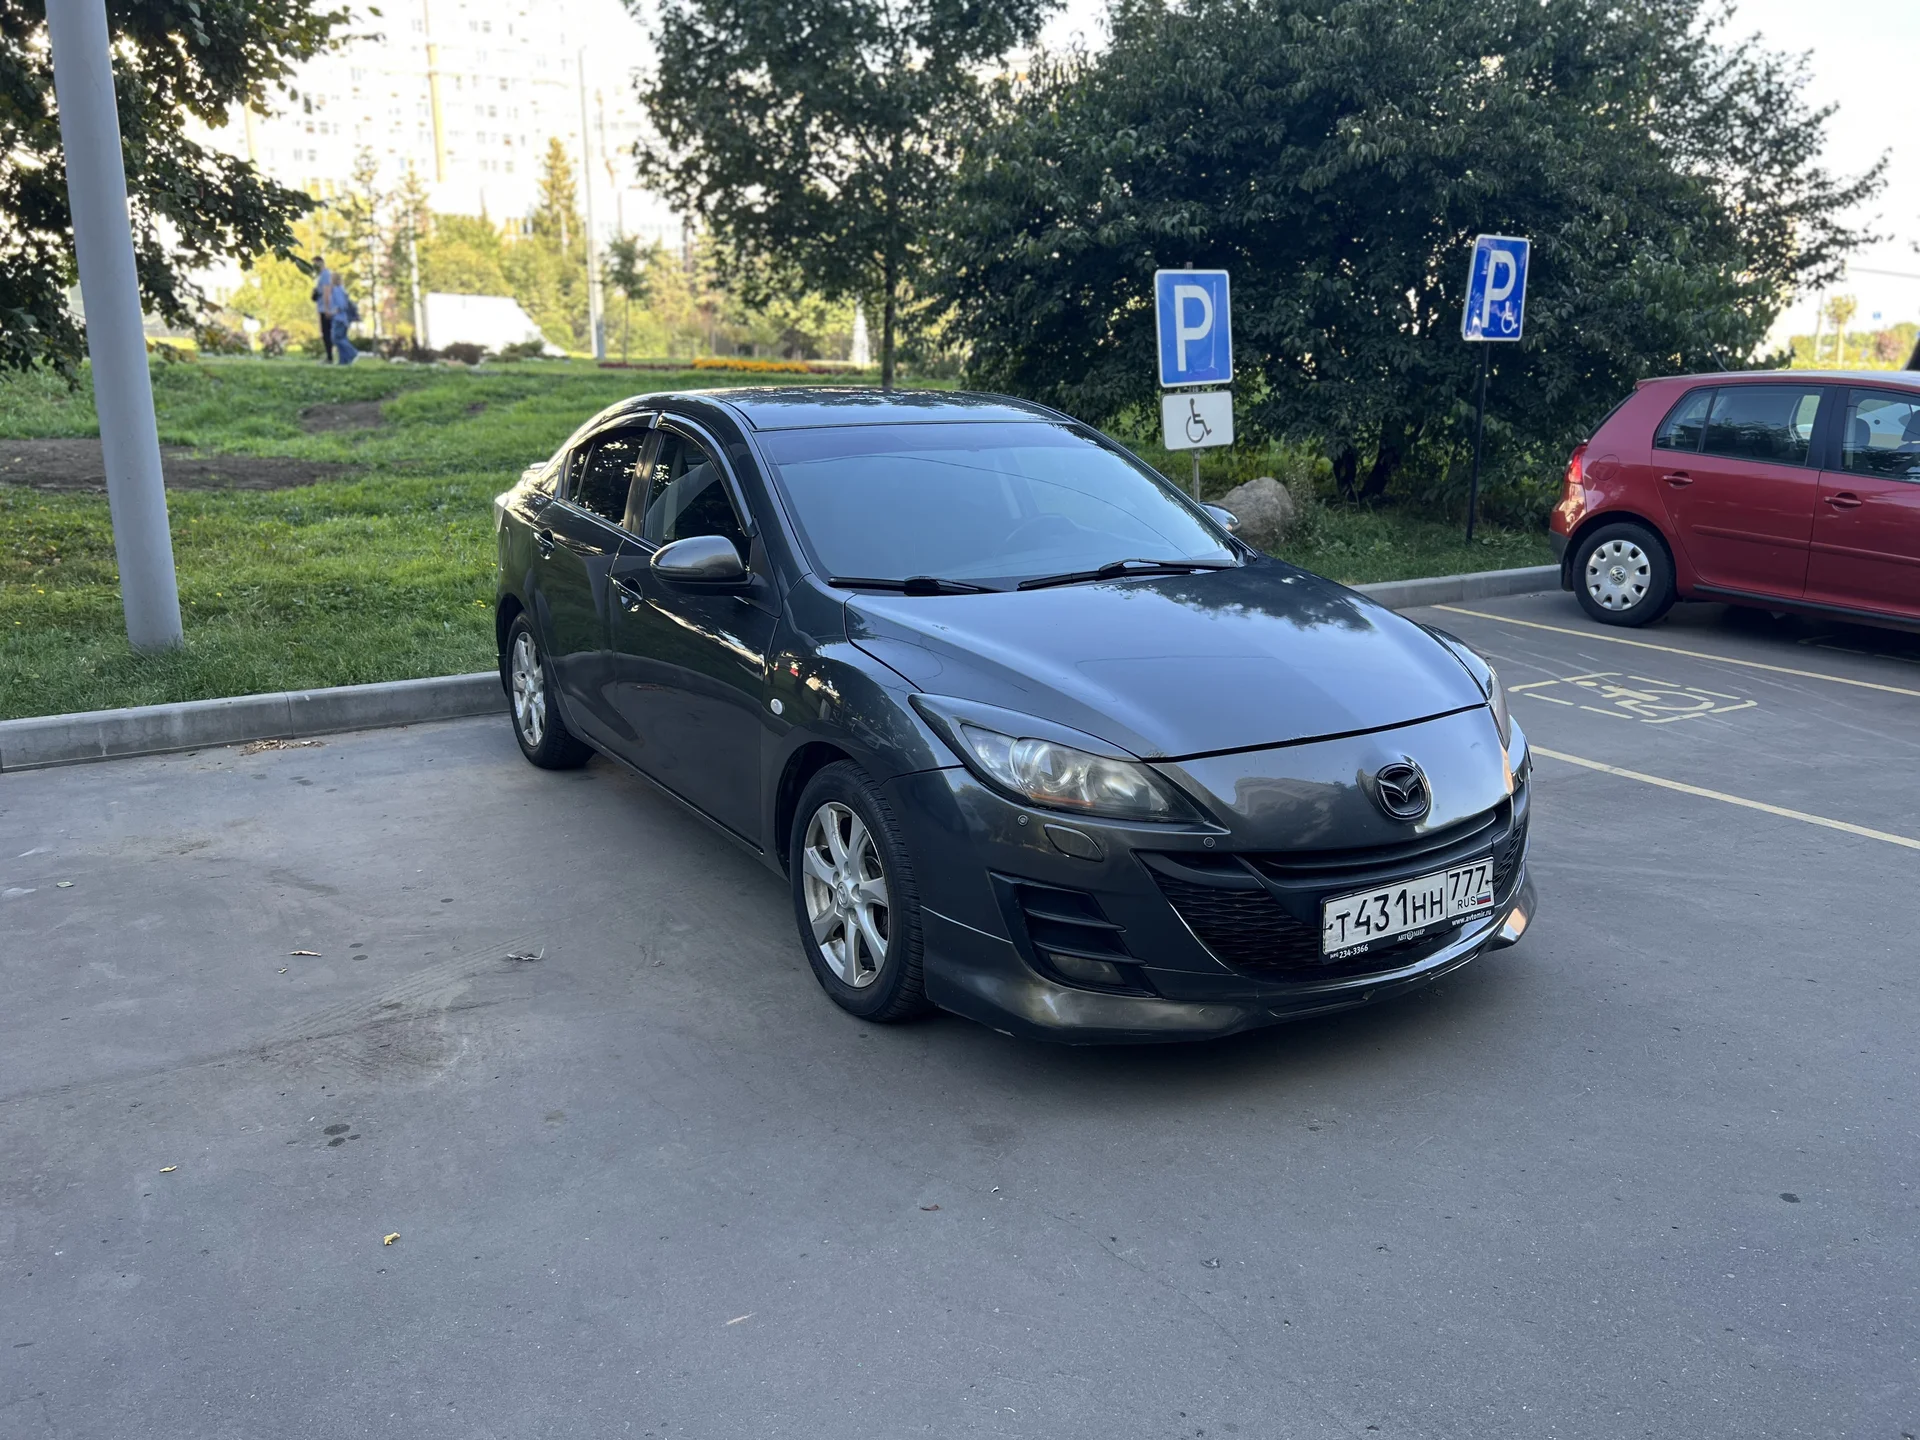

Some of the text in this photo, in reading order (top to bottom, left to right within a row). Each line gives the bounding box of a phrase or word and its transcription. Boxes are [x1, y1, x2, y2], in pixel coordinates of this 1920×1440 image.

[1481, 250, 1516, 328] P
[1174, 285, 1213, 372] P
[1449, 865, 1487, 901] 777
[1457, 895, 1477, 910] RUS
